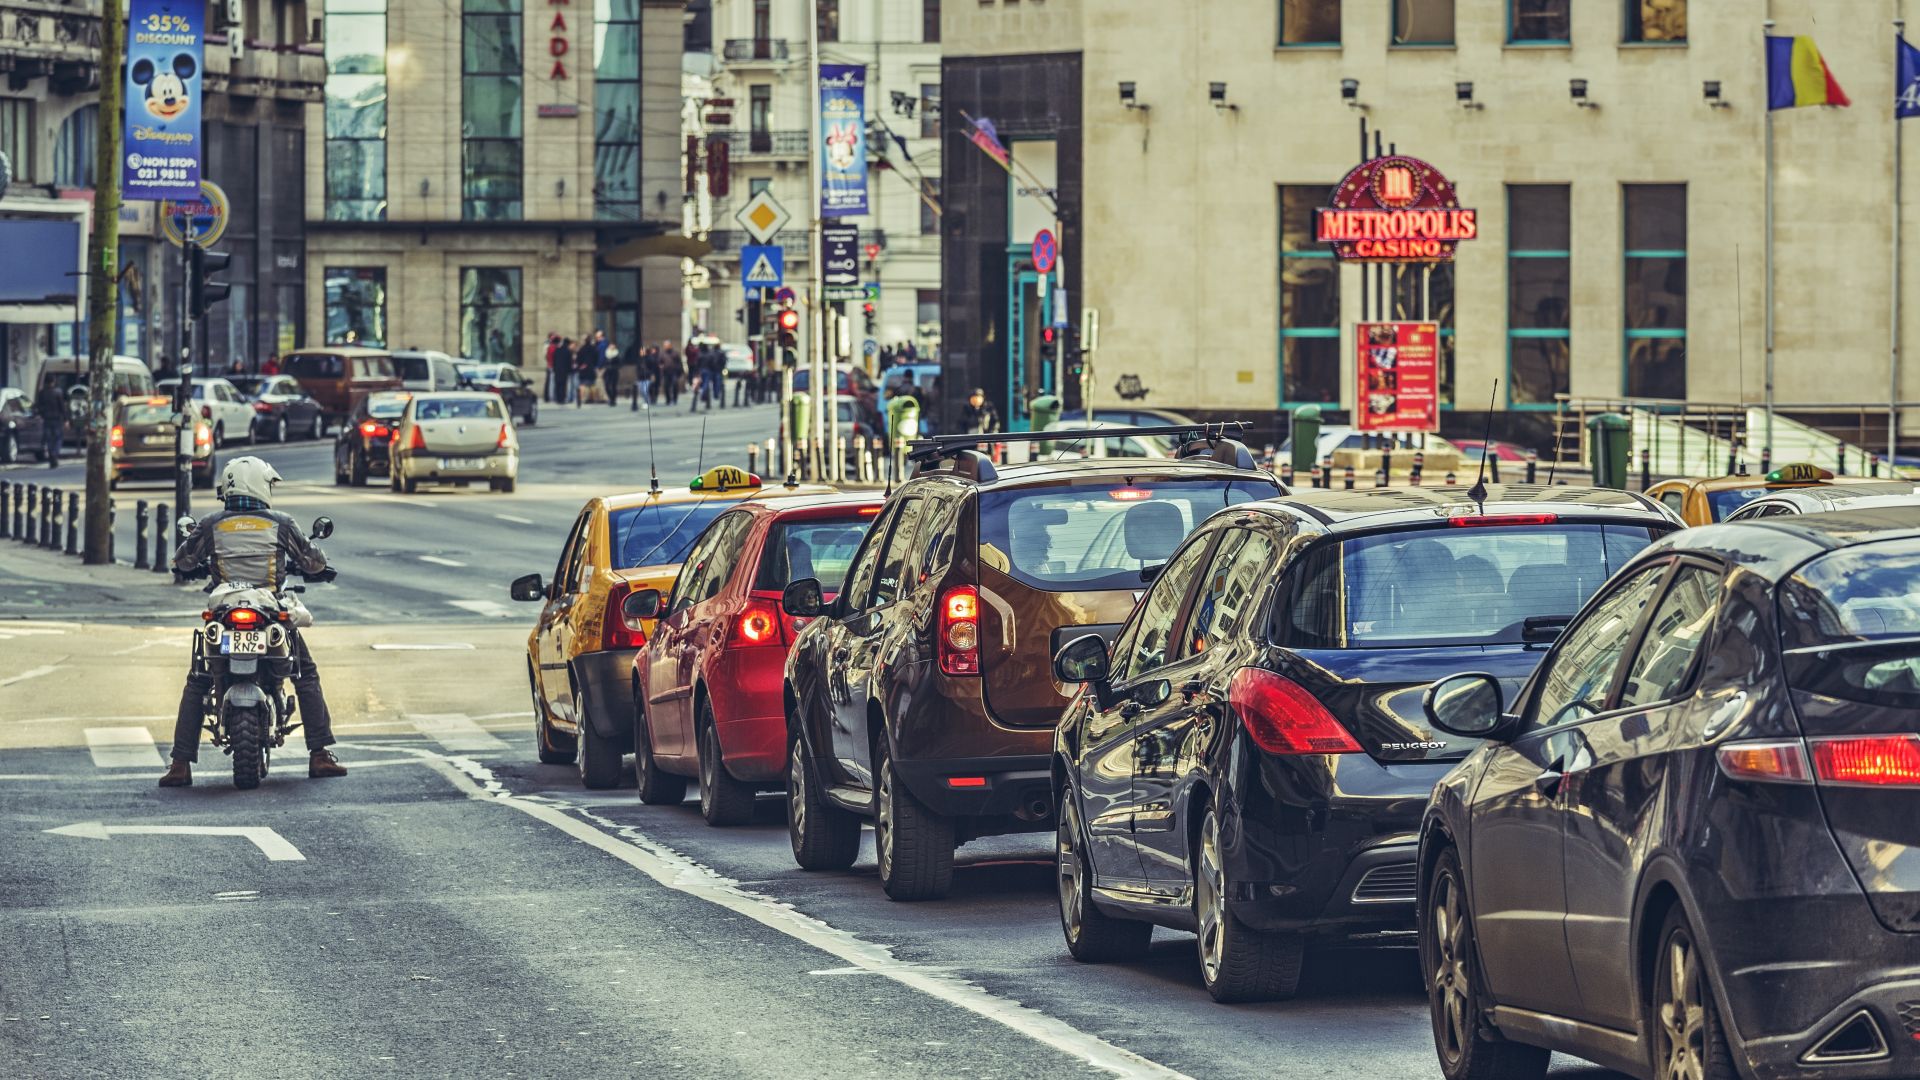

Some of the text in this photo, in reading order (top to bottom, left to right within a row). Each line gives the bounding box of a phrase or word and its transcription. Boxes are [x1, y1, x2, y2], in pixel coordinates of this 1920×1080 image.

[141, 14, 190, 32] -35%
[136, 33, 196, 45] DISCOUNT
[547, 0, 570, 80] ADA
[142, 157, 168, 168] NON
[138, 168, 187, 180] 021 9818
[1323, 210, 1476, 239] METROPOLIS
[1355, 239, 1441, 257] CASINO
[715, 469, 742, 485] TAXI
[1790, 464, 1814, 480] TAXI
[233, 632, 260, 642] B 06
[233, 642, 257, 652] KNZ
[1381, 741, 1447, 750] PEUGEOT
